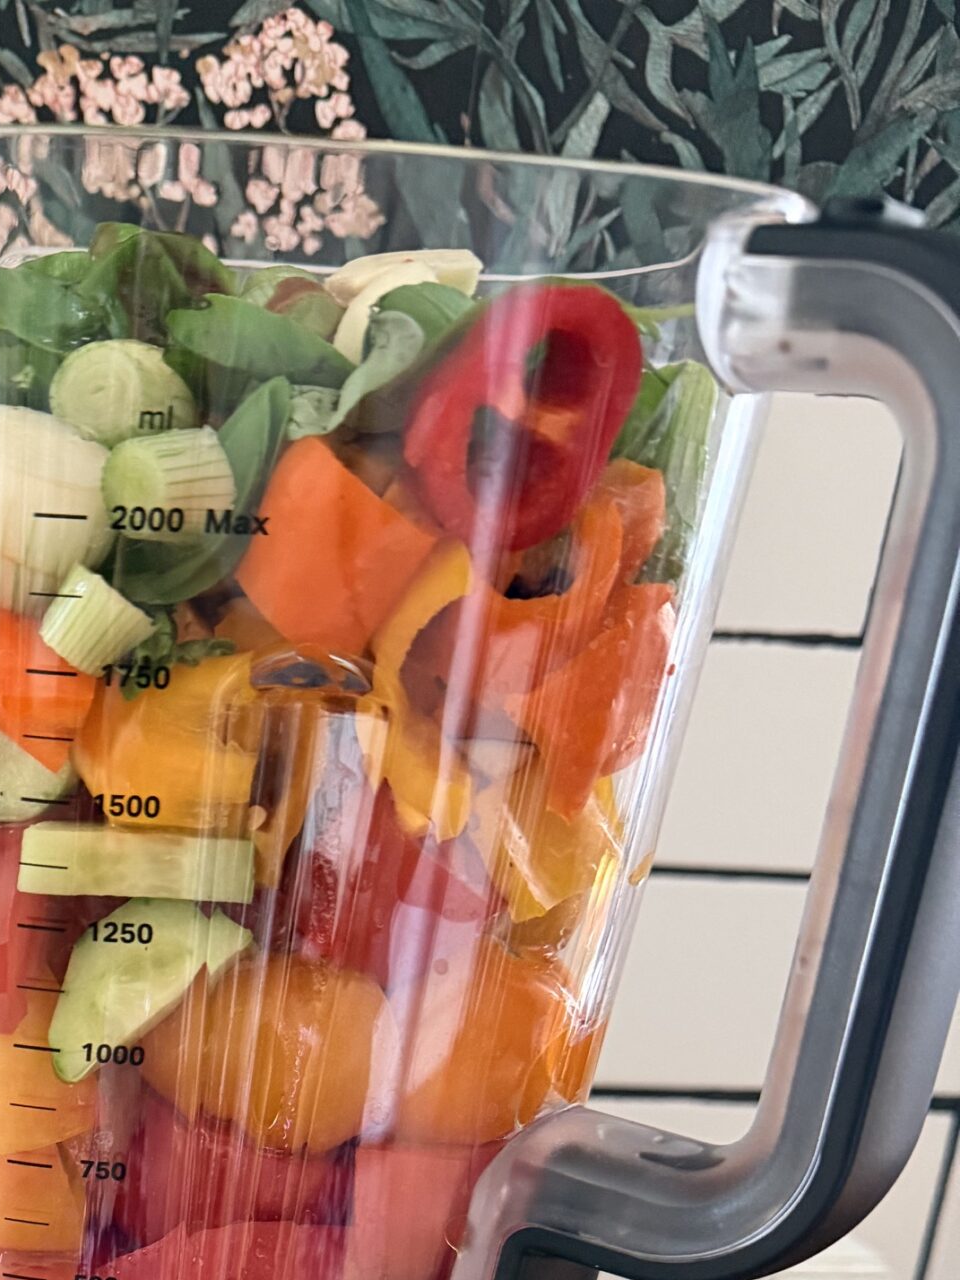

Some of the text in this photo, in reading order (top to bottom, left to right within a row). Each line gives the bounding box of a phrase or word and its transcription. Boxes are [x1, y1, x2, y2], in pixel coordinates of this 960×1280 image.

[138, 405, 173, 430] ml
[110, 506, 269, 536] 2000 Max
[102, 663, 170, 689] 1750
[94, 793, 160, 818] 1500
[87, 920, 153, 945] 1250
[81, 1042, 145, 1066] 1000
[80, 1160, 126, 1182] 750
